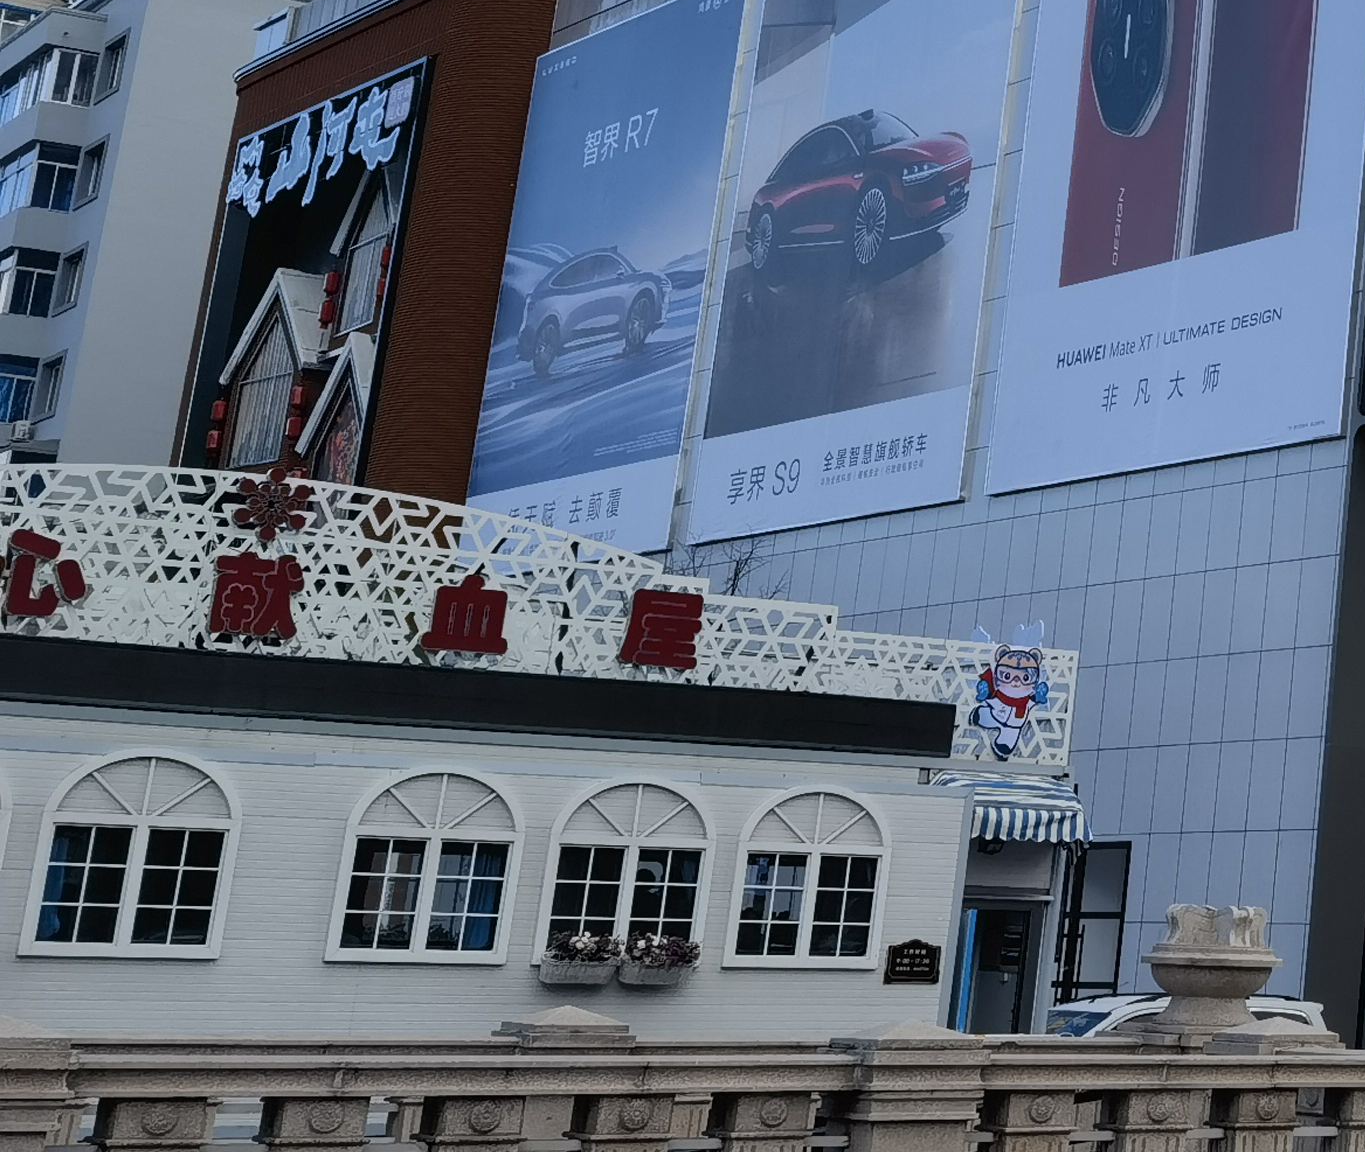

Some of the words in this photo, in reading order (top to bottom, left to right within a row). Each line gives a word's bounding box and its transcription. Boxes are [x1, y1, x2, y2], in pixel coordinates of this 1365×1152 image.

[583, 121, 621, 168] 智界
[624, 107, 659, 153] R7
[1111, 187, 1126, 266] DESIGN
[1056, 344, 1107, 369] HUAWEI
[1109, 338, 1136, 359] Mate
[1138, 333, 1154, 352] XT
[1163, 320, 1226, 346] ULTIMATE
[1231, 307, 1283, 331] DESIGN
[1101, 362, 1221, 413] 非凡大师
[822, 432, 928, 472] 全景智慧旗舰轿车
[568, 487, 623, 525] 去颠覆
[727, 465, 767, 505] 享界
[772, 458, 801, 496] S9
